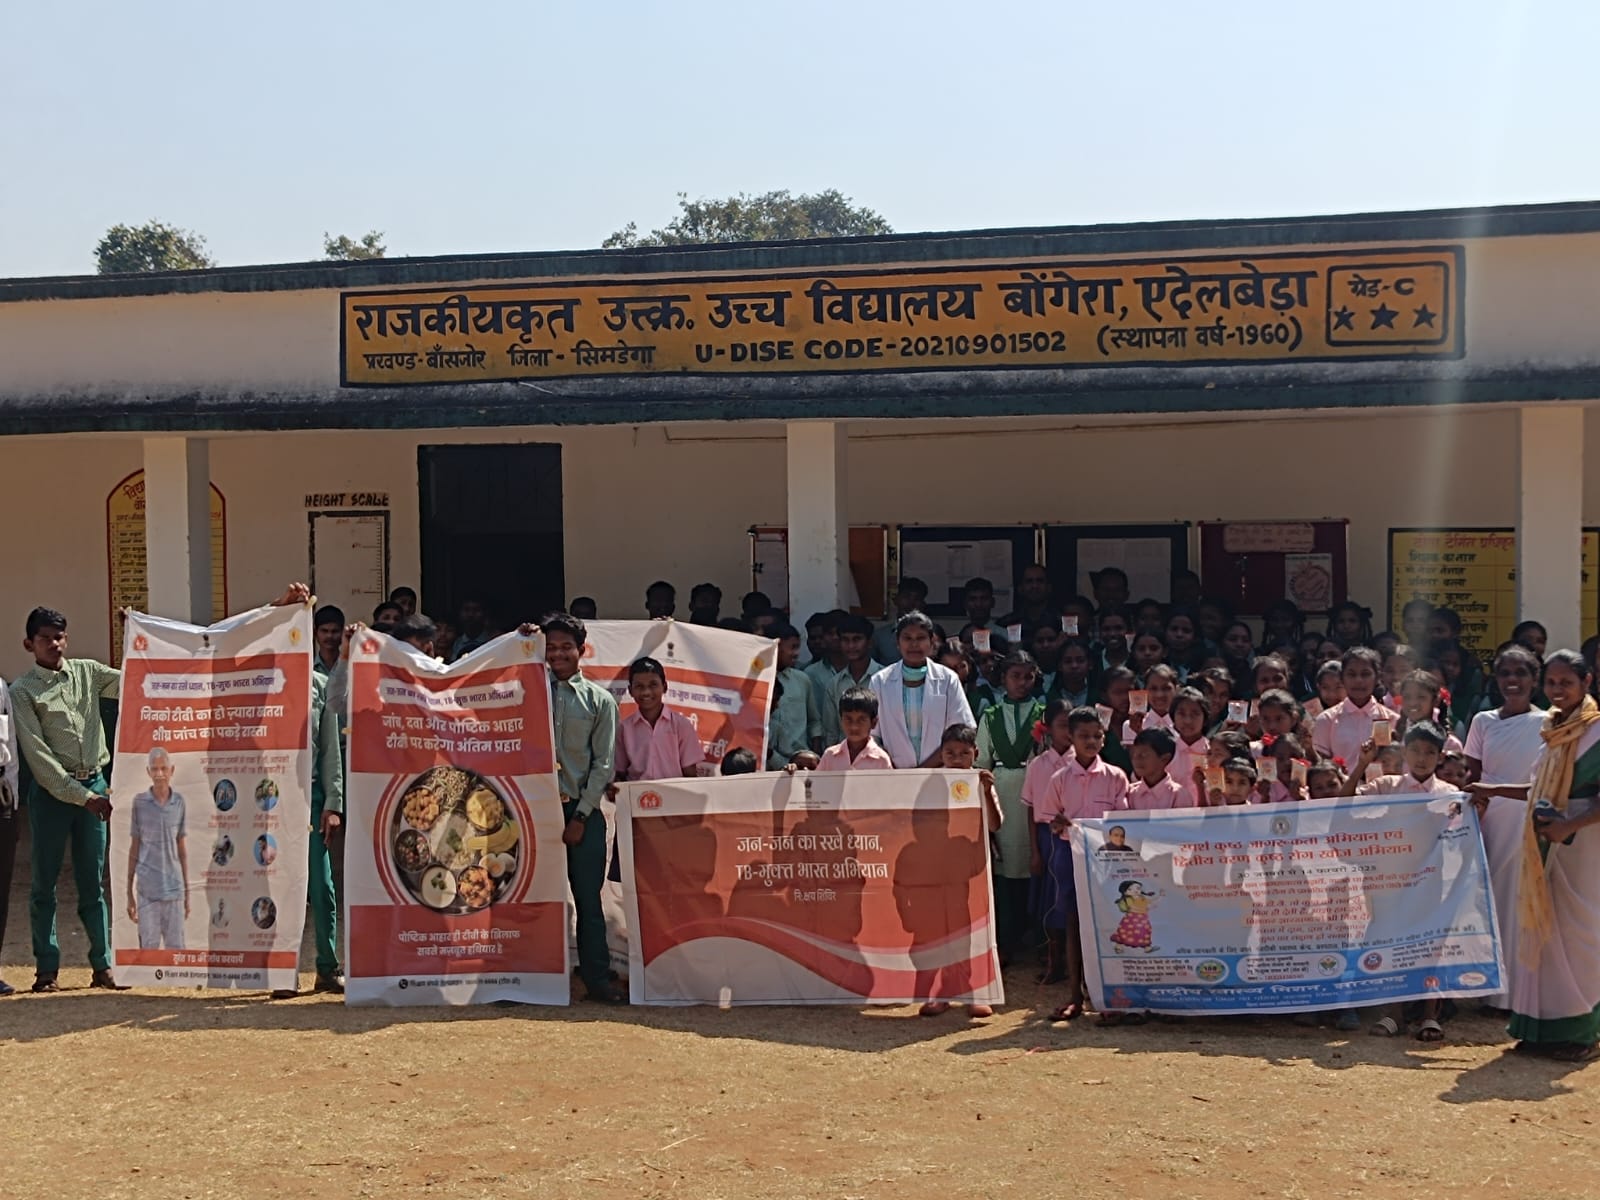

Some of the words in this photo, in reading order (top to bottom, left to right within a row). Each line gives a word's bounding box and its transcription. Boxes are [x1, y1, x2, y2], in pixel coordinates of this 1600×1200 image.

[353, 295, 581, 343] राजकीयकृत
[706, 291, 792, 328] उच्च
[805, 279, 983, 325] विद्यालय
[997, 271, 1129, 325] बोंगेरा,
[1097, 322, 1187, 357] (स्थापना
[1195, 315, 1303, 352] वर्ष-1960)
[507, 343, 553, 367] जिला
[571, 340, 657, 367] सिमडेगा
[695, 340, 795, 364] U-DISE
[804, 331, 1067, 361] CODE-20210901502
[304, 494, 346, 507] HEIGHT
[351, 493, 389, 507] SCALE
[140, 705, 171, 721] जिनको
[172, 706, 194, 721] टीबी
[195, 709, 212, 720] का
[173, 726, 197, 741] जांच
[198, 728, 215, 738] का
[406, 717, 424, 730] दवा
[491, 718, 524, 732] आहार
[409, 736, 422, 747] पर
[423, 734, 454, 751] करेगा
[456, 737, 491, 753] अंतिम
[495, 738, 522, 752] प्रहार
[736, 836, 794, 853] जन-जन
[797, 836, 817, 852] का
[847, 835, 883, 853] ध्यान,
[1326, 831, 1379, 843] अभियान
[1358, 844, 1412, 856] अभियान
[736, 863, 794, 887] TB-मुक्त
[797, 863, 829, 879] भारत
[832, 856, 888, 879] अभियान
